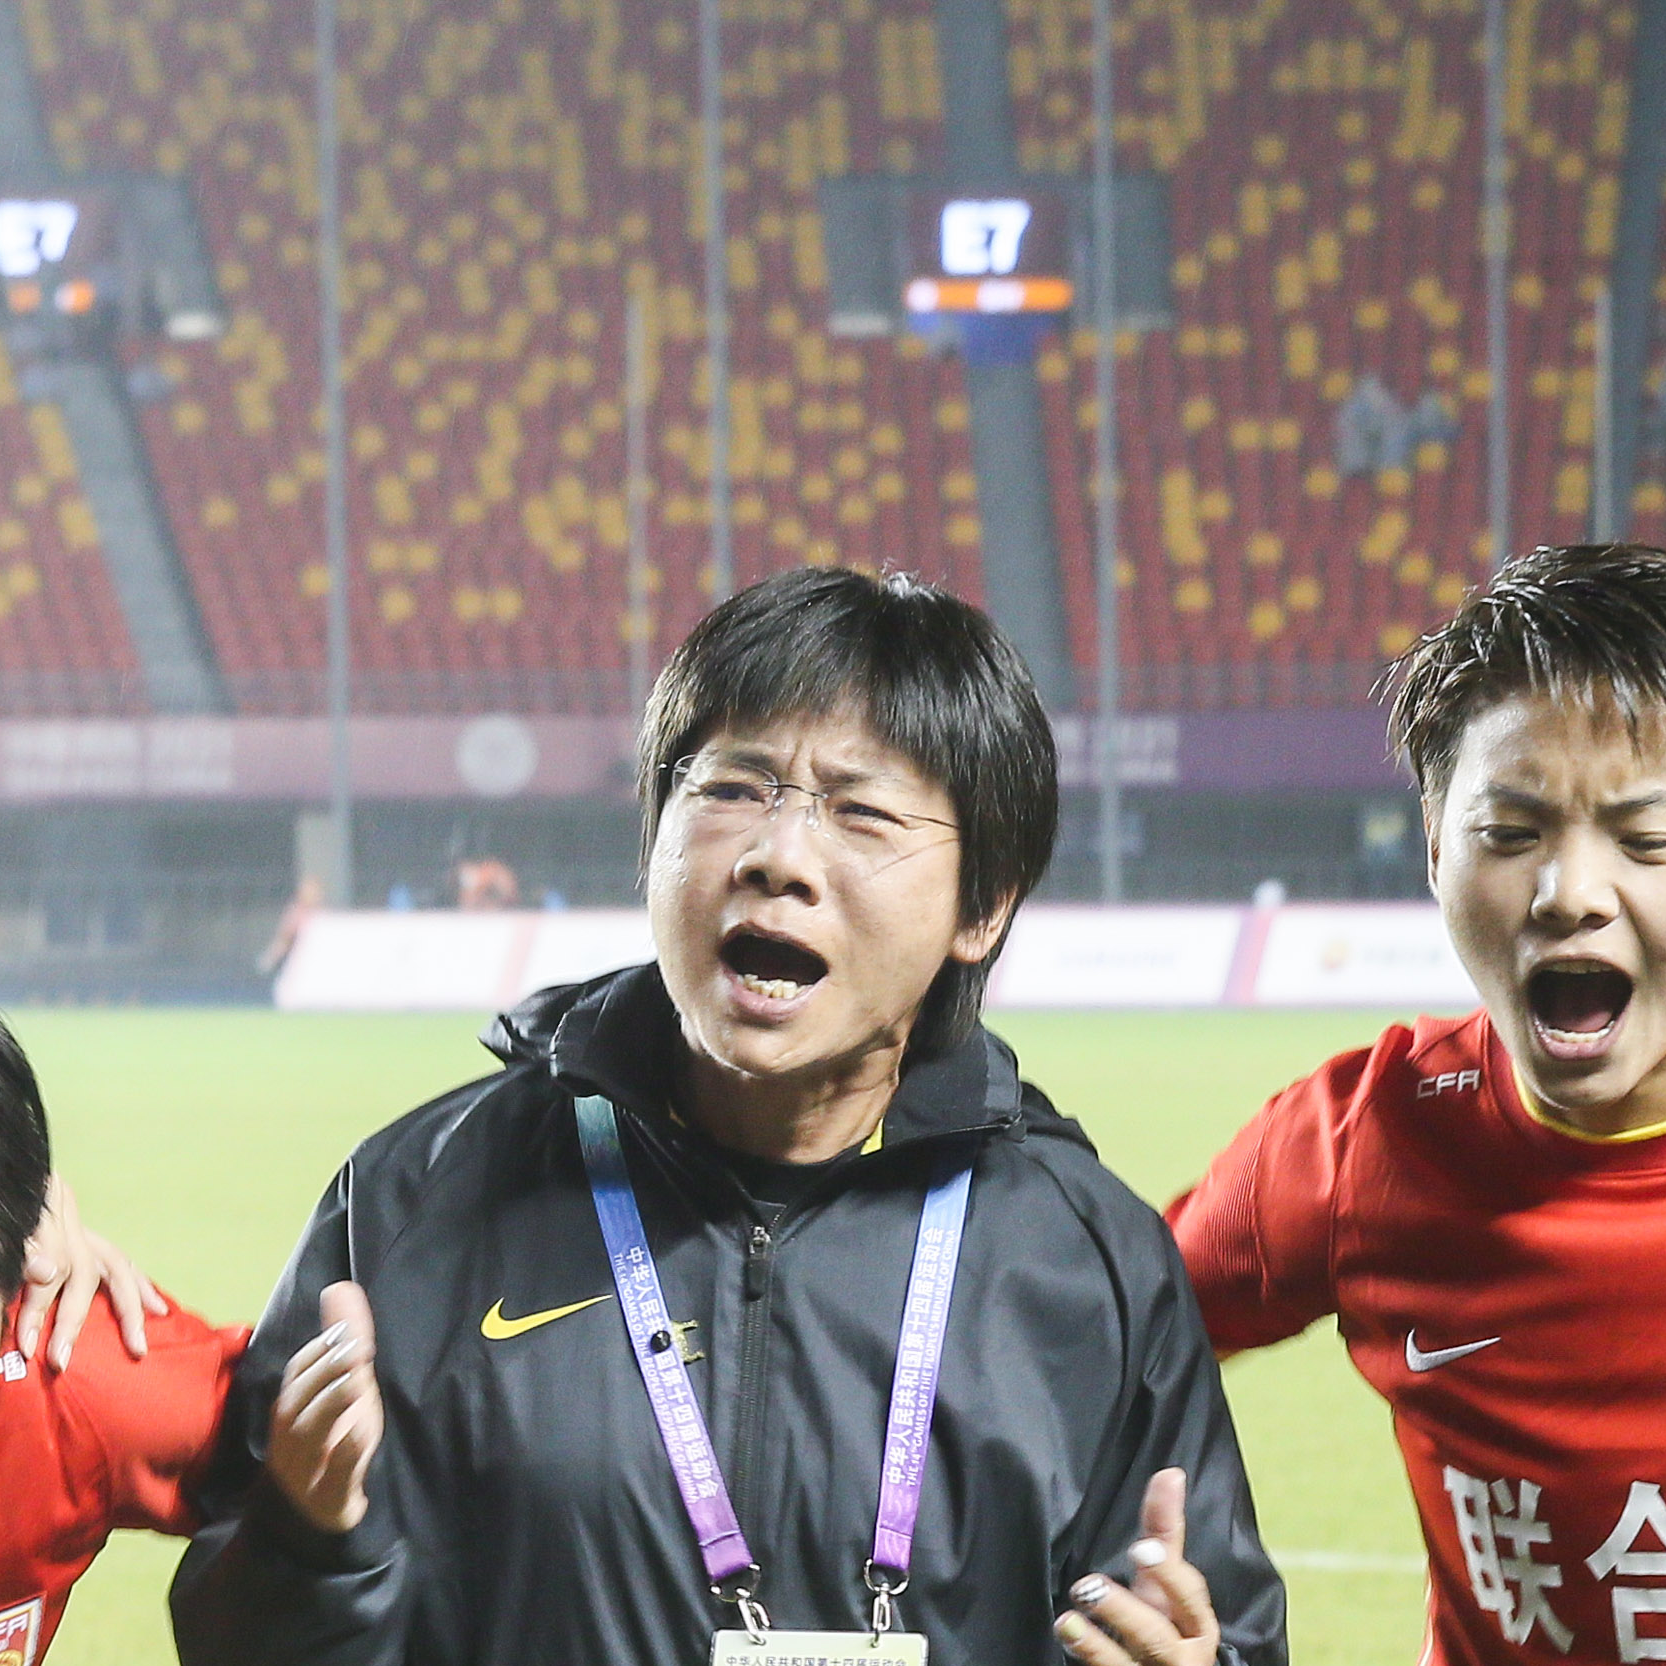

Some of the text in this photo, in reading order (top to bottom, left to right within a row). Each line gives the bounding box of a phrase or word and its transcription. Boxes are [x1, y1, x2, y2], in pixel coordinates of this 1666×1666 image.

[1417, 1069, 1481, 1101] CFA
[612, 1251, 627, 1273] THE
[885, 1227, 945, 1485] 中华人民共和国第十四届运动会
[625, 1245, 718, 1501] 中华人民共国第十四届运动会
[919, 1368, 933, 1392] THE
[916, 1391, 929, 1408] OF
[911, 1407, 928, 1447] GAMES
[905, 1464, 918, 1487] THE
